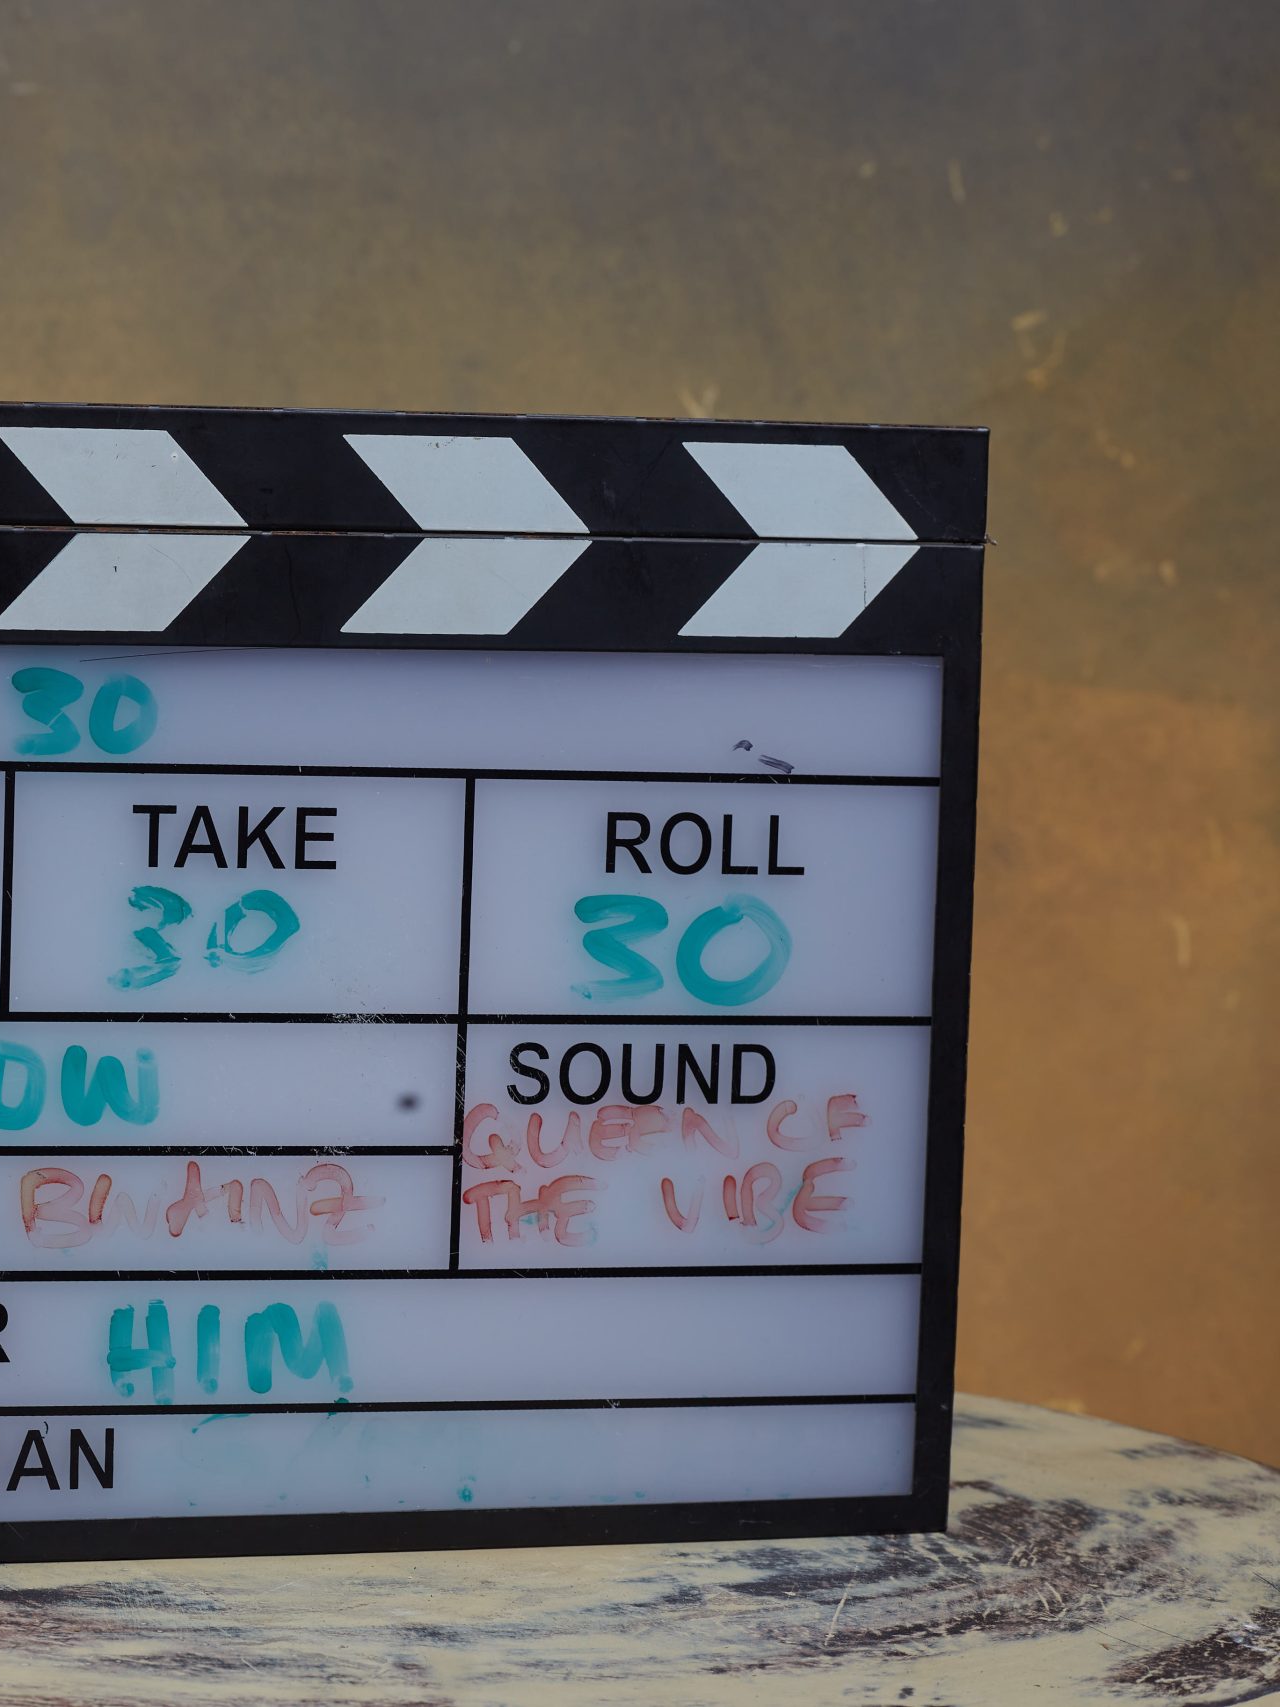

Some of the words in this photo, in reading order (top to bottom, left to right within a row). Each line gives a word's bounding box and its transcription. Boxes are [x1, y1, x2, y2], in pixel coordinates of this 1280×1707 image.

[11, 666, 160, 756] 30
[132, 804, 338, 870] TAKE
[605, 811, 806, 877] ROLL
[108, 885, 301, 991] 30
[571, 892, 793, 1007] 30
[506, 1041, 778, 1106] SOUND
[462, 1173, 608, 1248] THE
[659, 1156, 857, 1246] VIBE
[105, 1300, 356, 1405] HIM
